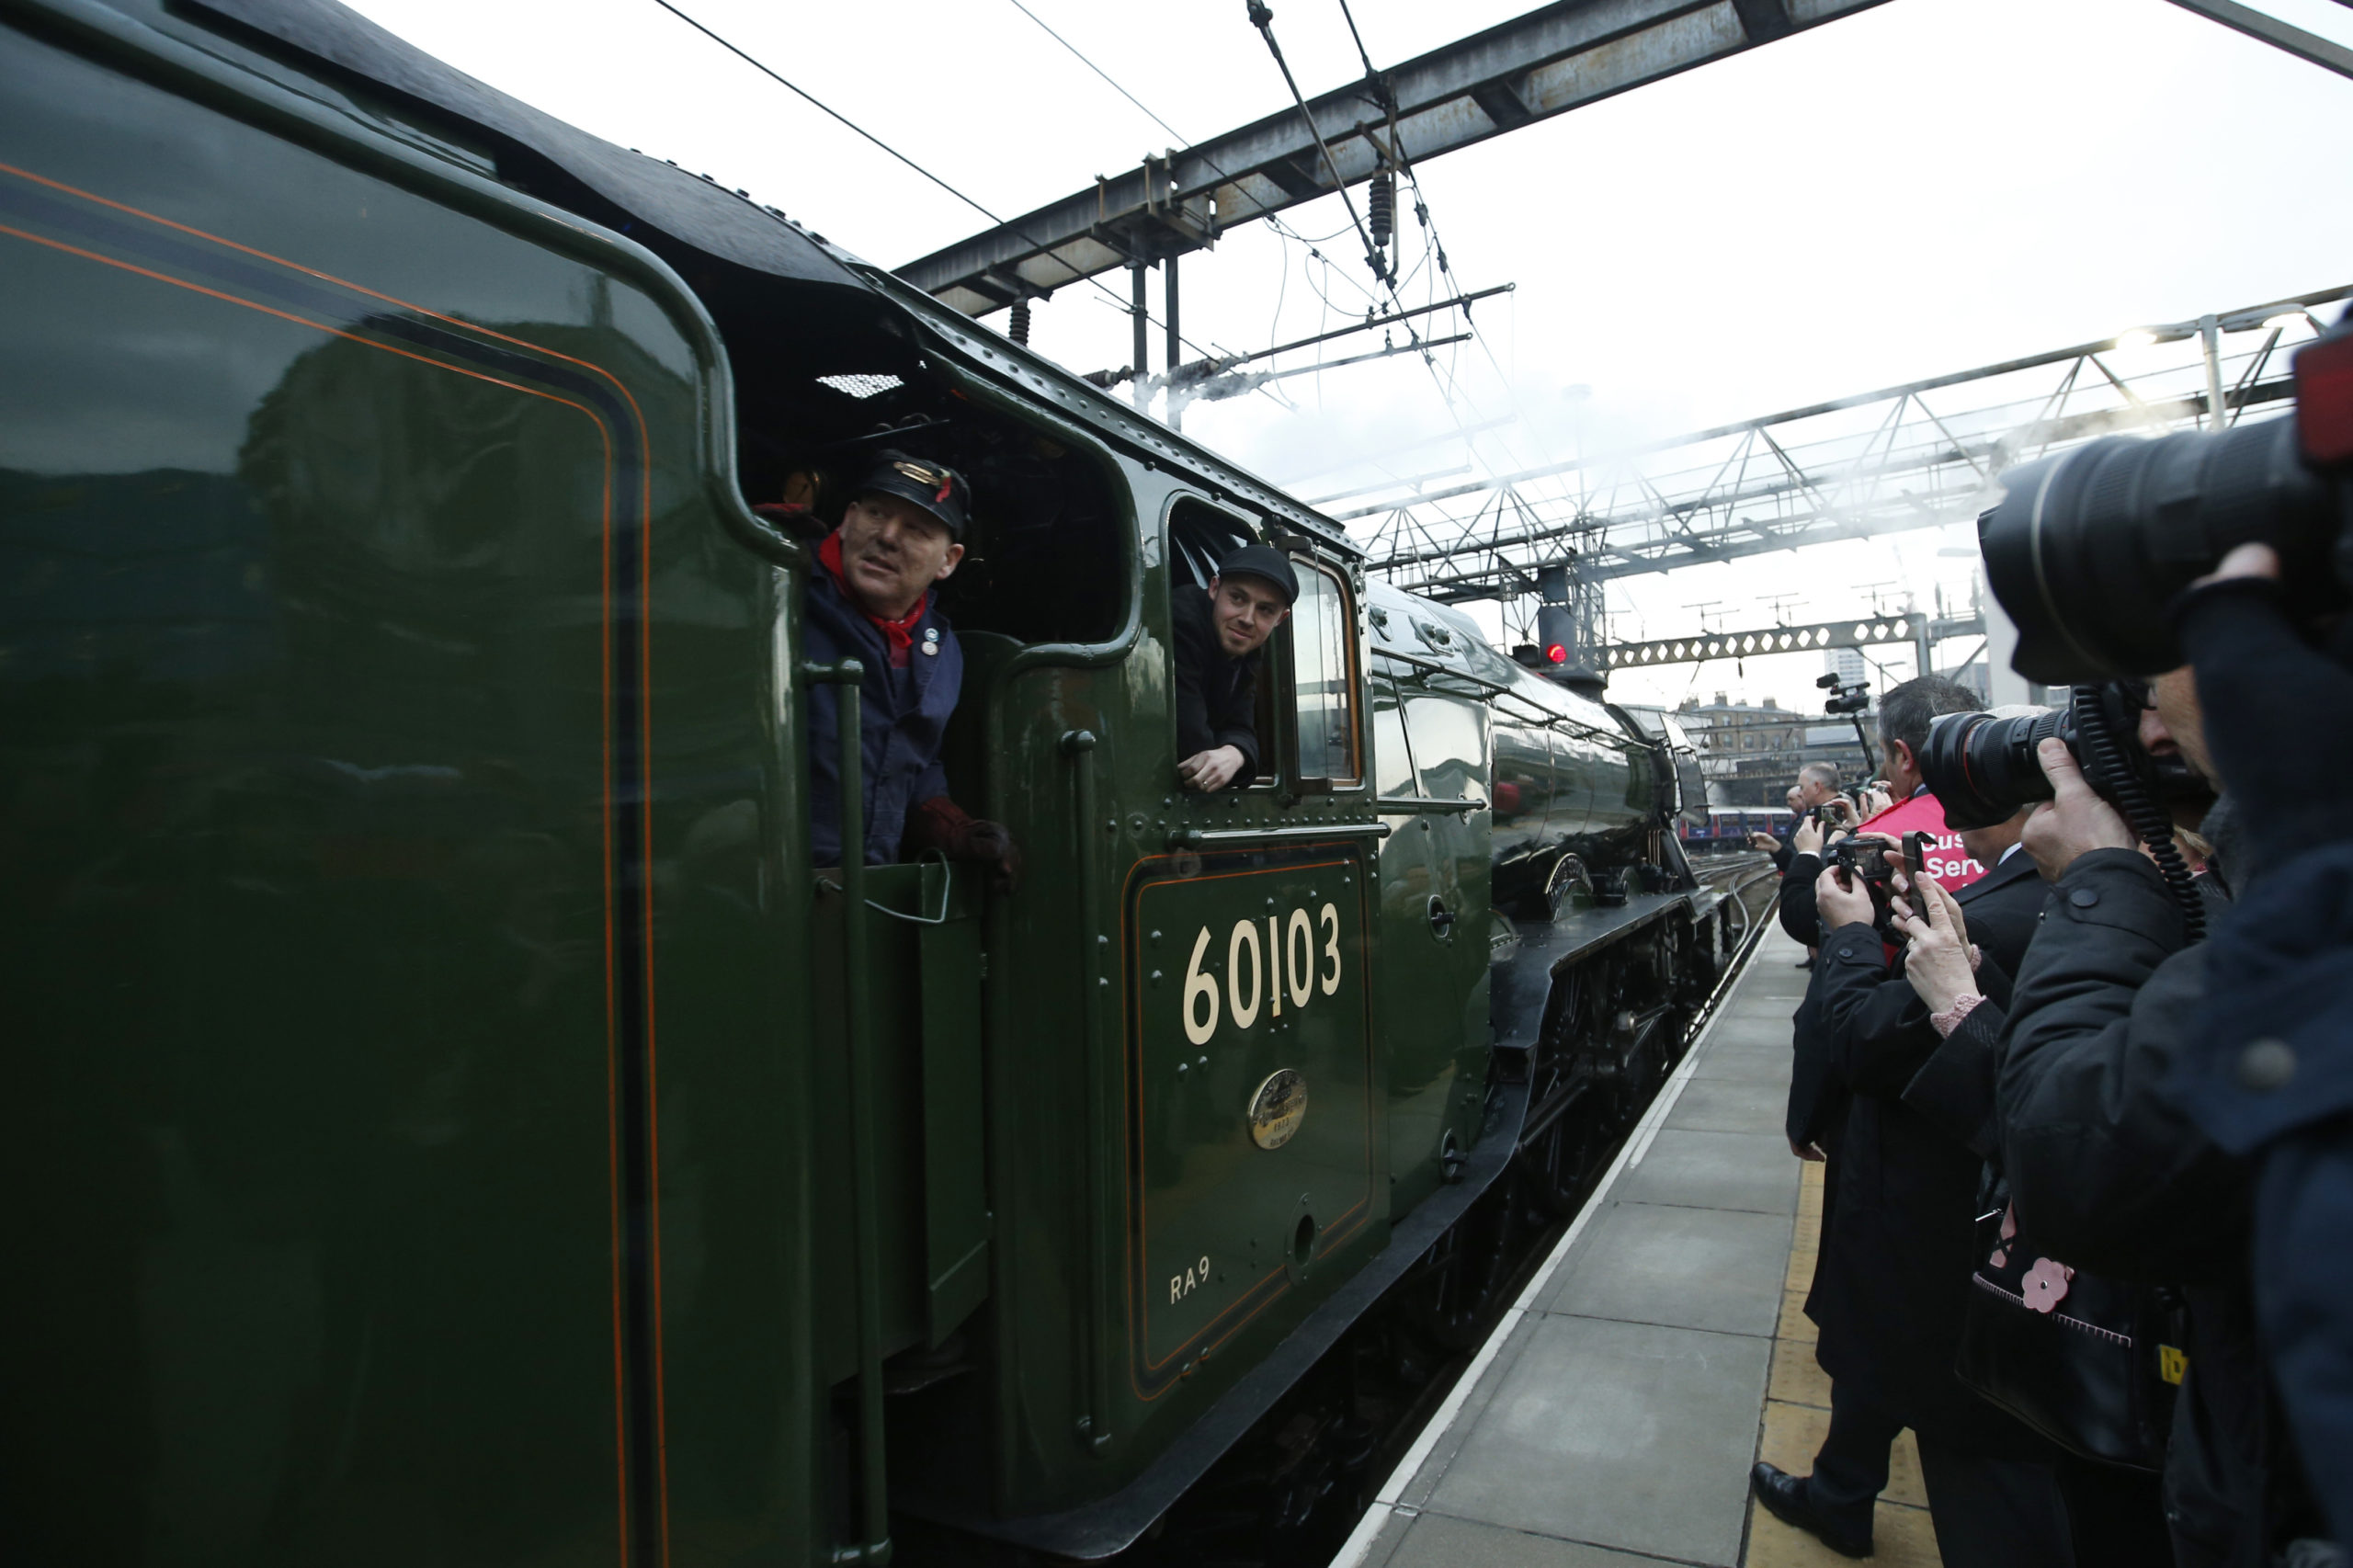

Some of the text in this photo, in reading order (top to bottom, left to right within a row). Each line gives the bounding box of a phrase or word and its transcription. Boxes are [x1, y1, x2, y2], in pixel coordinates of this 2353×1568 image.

[1506, 584, 1512, 592] K
[1183, 902, 1342, 1046] 60103
[1170, 1256, 1209, 1304] RA9
